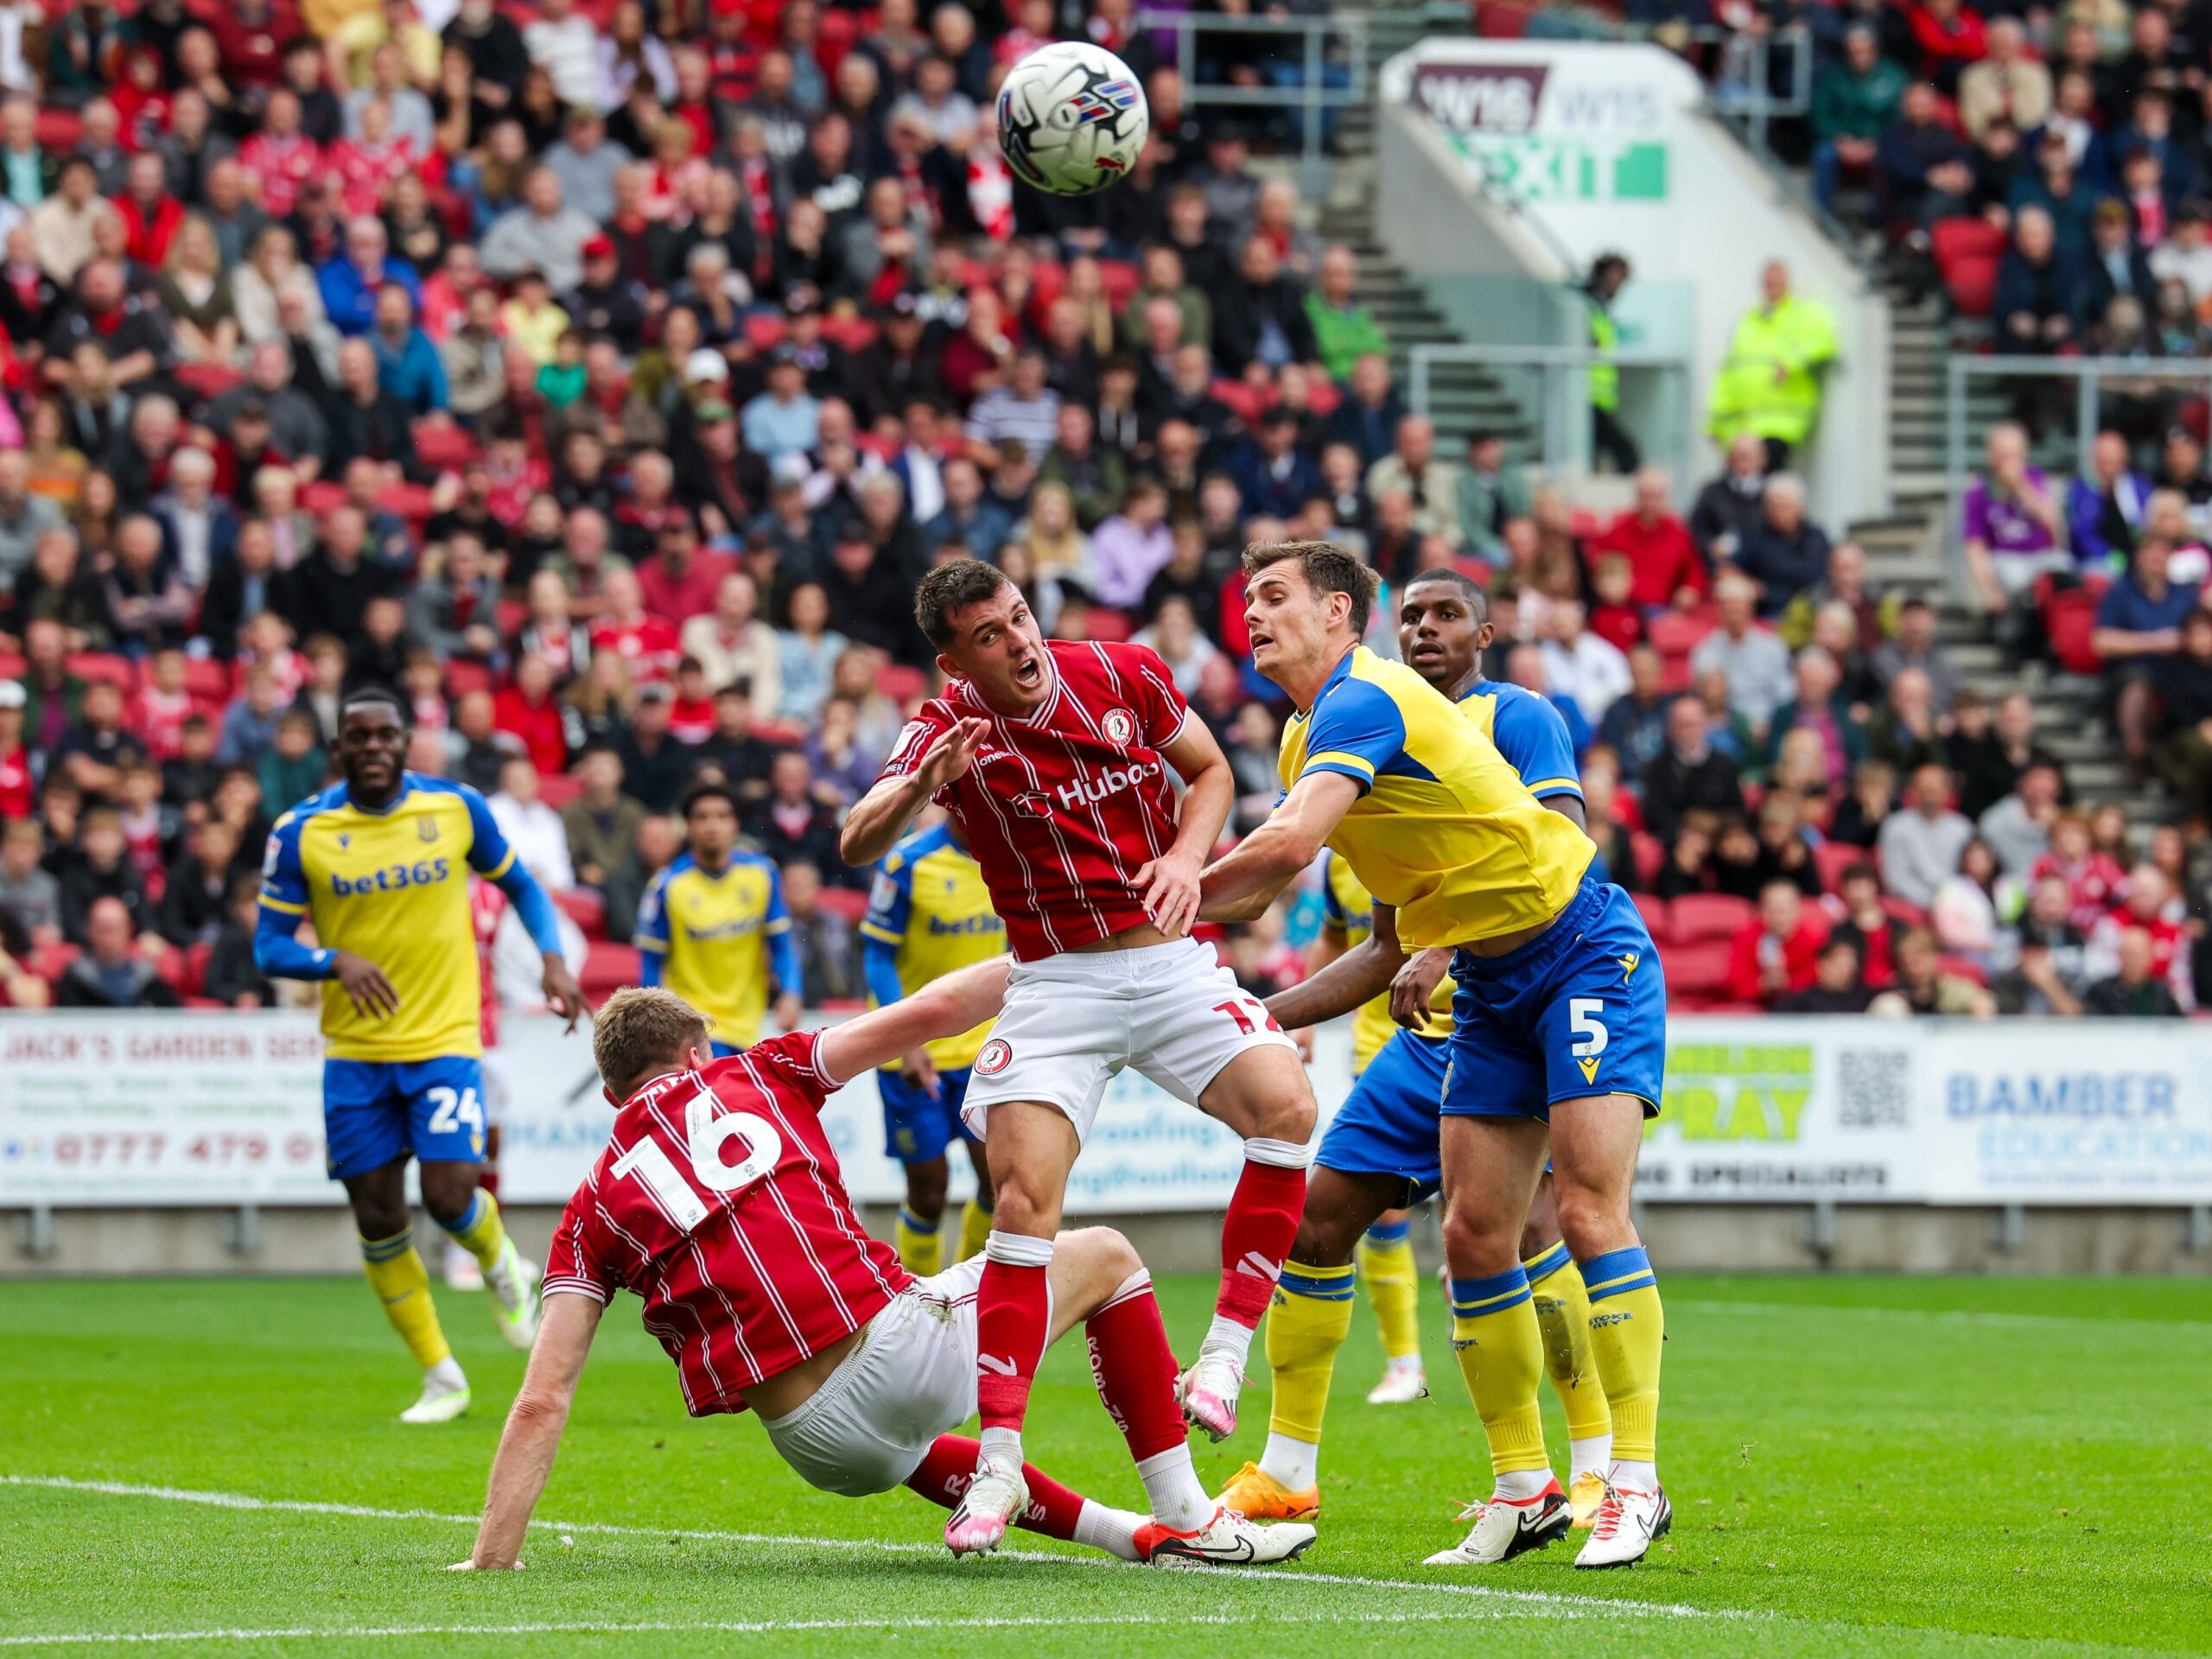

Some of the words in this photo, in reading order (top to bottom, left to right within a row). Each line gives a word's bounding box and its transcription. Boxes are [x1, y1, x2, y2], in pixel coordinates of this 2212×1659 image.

[1415, 73, 1536, 131] W16
[331, 858, 448, 897] bet365
[5, 1033, 114, 1060] JACK'S
[128, 1033, 253, 1060] GARDEN
[1569, 998, 1609, 1057] 5
[427, 1086, 485, 1134] 24
[1947, 1071, 2177, 1118] BAMBER
[54, 1133, 167, 1165] 0777
[187, 1133, 267, 1163] 479
[608, 1086, 783, 1233] 16
[1087, 1336, 1129, 1433] ROBINS
